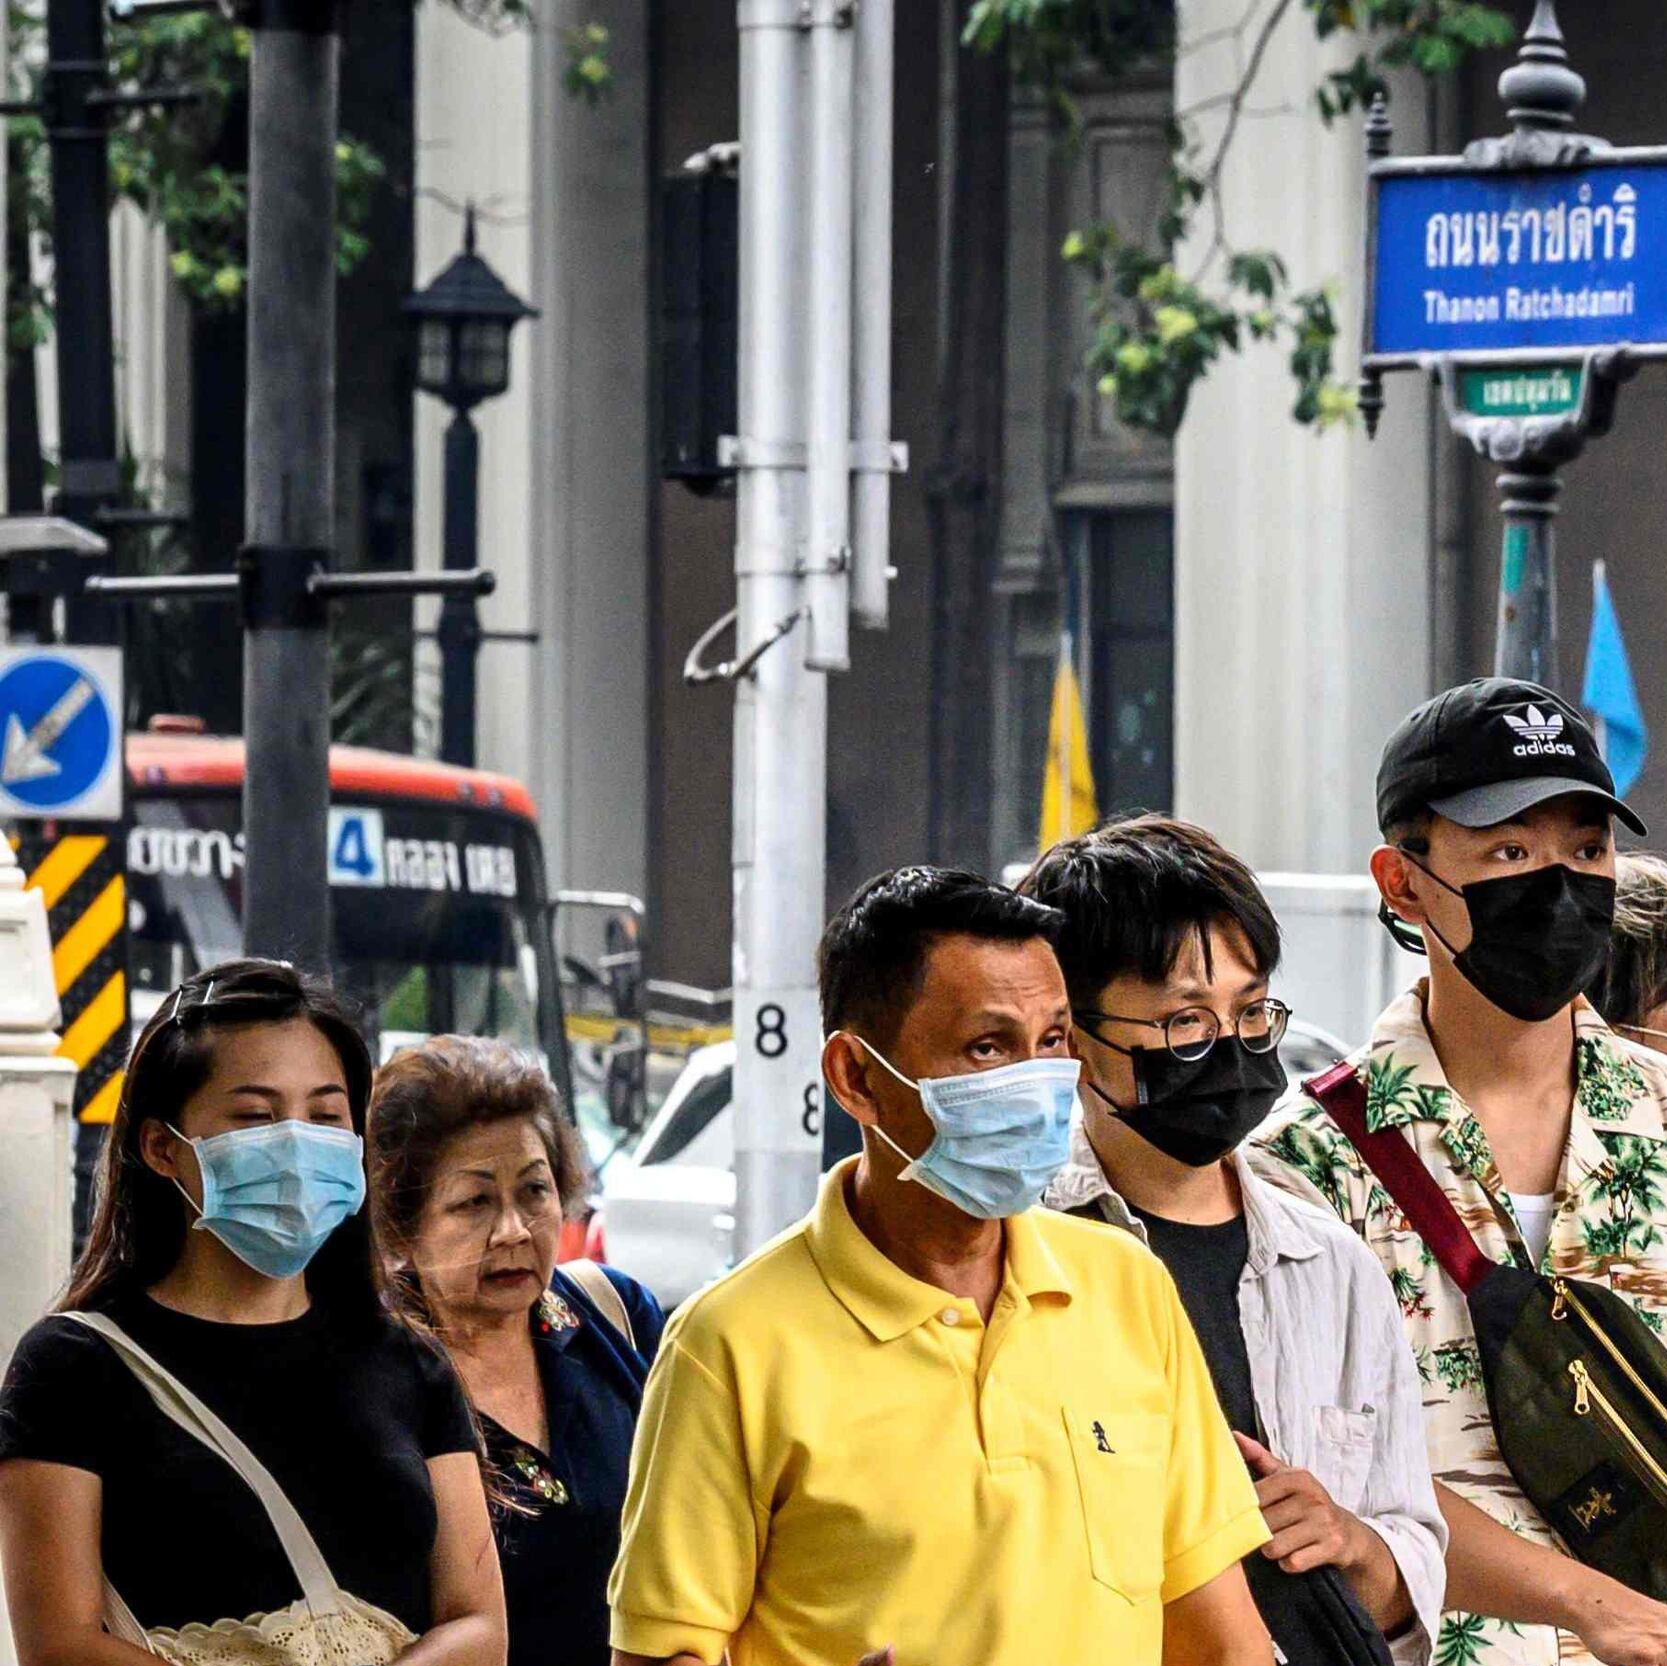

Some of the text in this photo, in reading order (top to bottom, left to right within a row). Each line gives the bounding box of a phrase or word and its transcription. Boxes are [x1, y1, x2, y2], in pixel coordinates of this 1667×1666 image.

[1425, 183, 1637, 269] ถนนราชดำริ
[1424, 283, 1634, 324] Thanon Ratchadamri
[1513, 740, 1576, 757] adidas
[756, 1003, 788, 1058] 8
